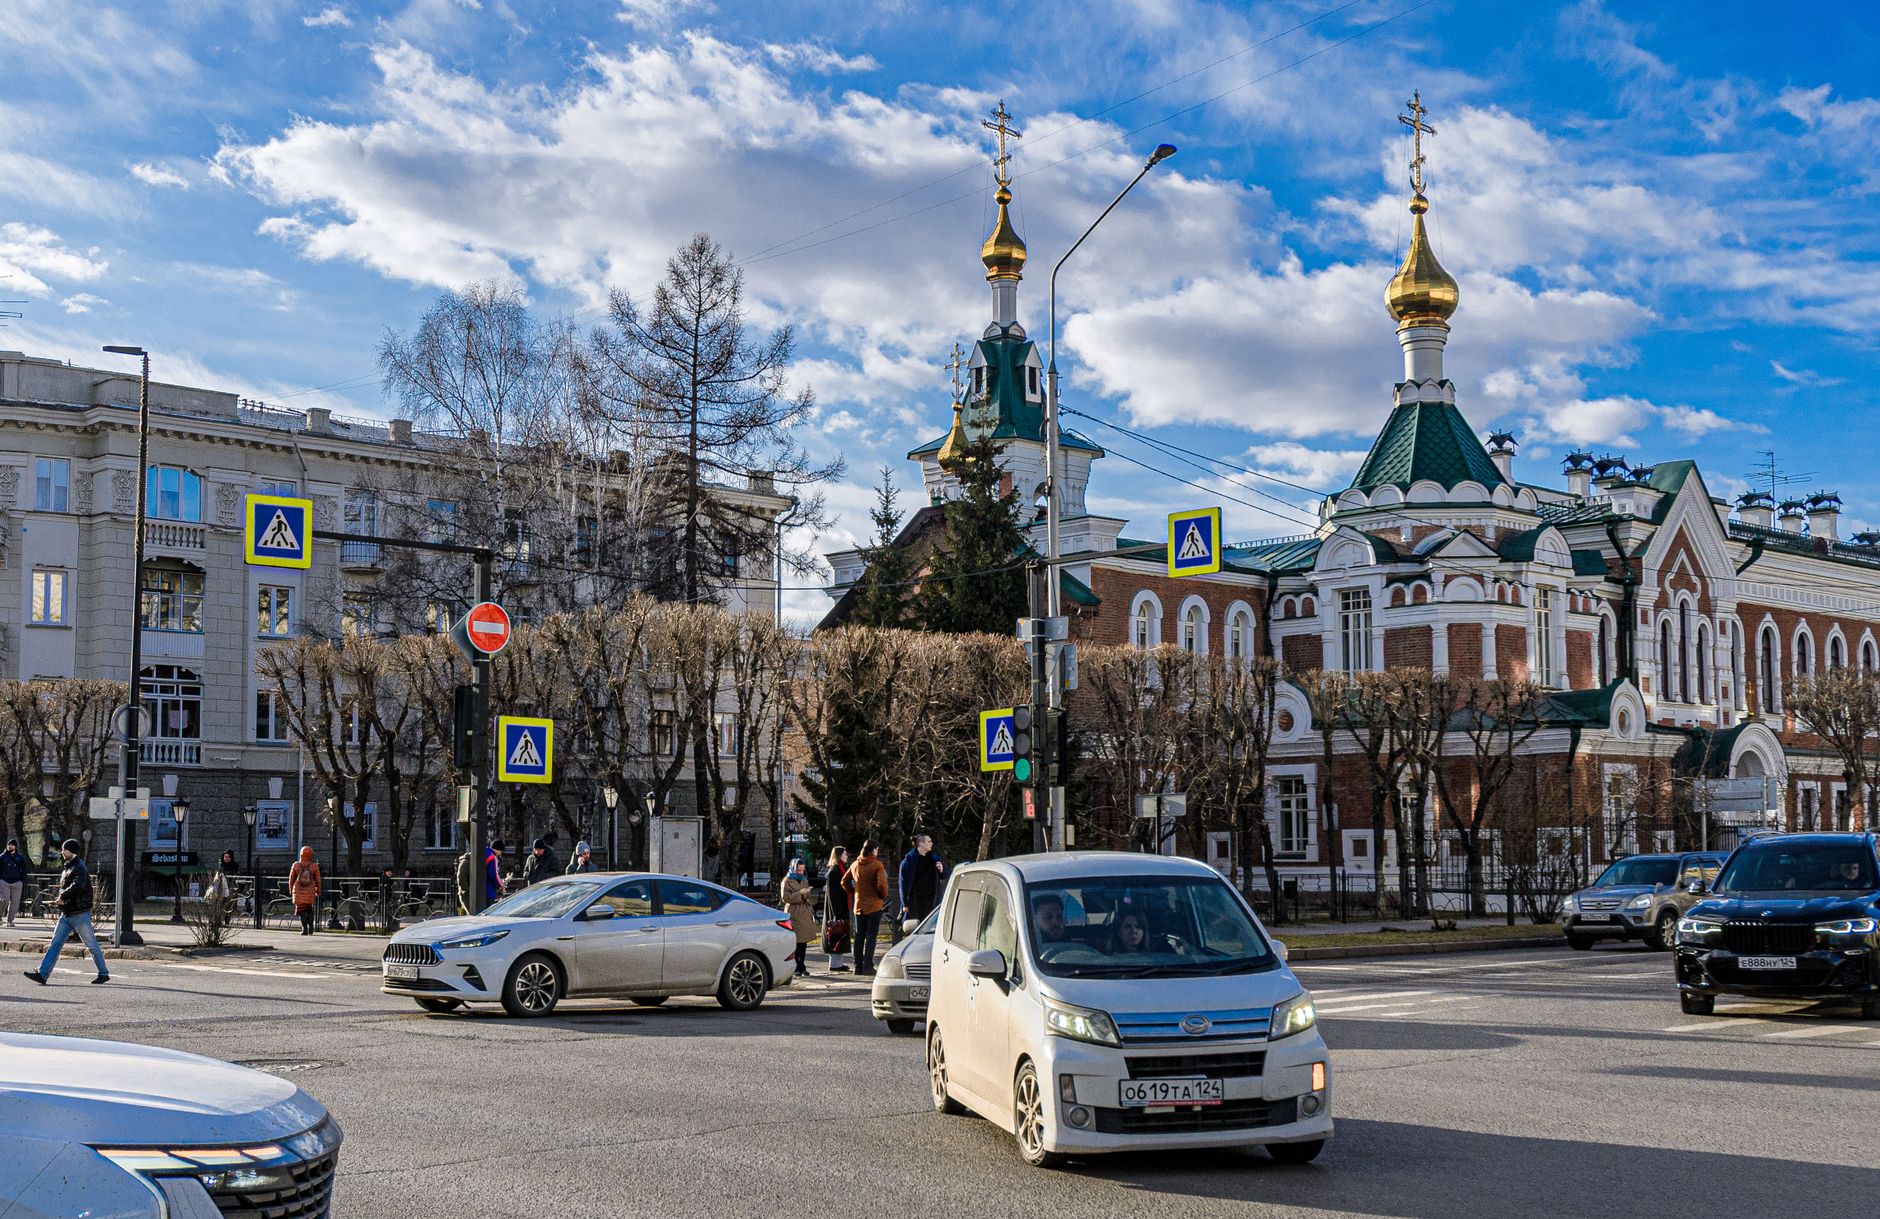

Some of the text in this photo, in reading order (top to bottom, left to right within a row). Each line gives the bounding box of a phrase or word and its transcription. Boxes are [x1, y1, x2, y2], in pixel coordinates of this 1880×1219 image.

[1741, 957, 1795, 968] Е888НУ 124
[1125, 1081, 1220, 1100] О619ТА 124
